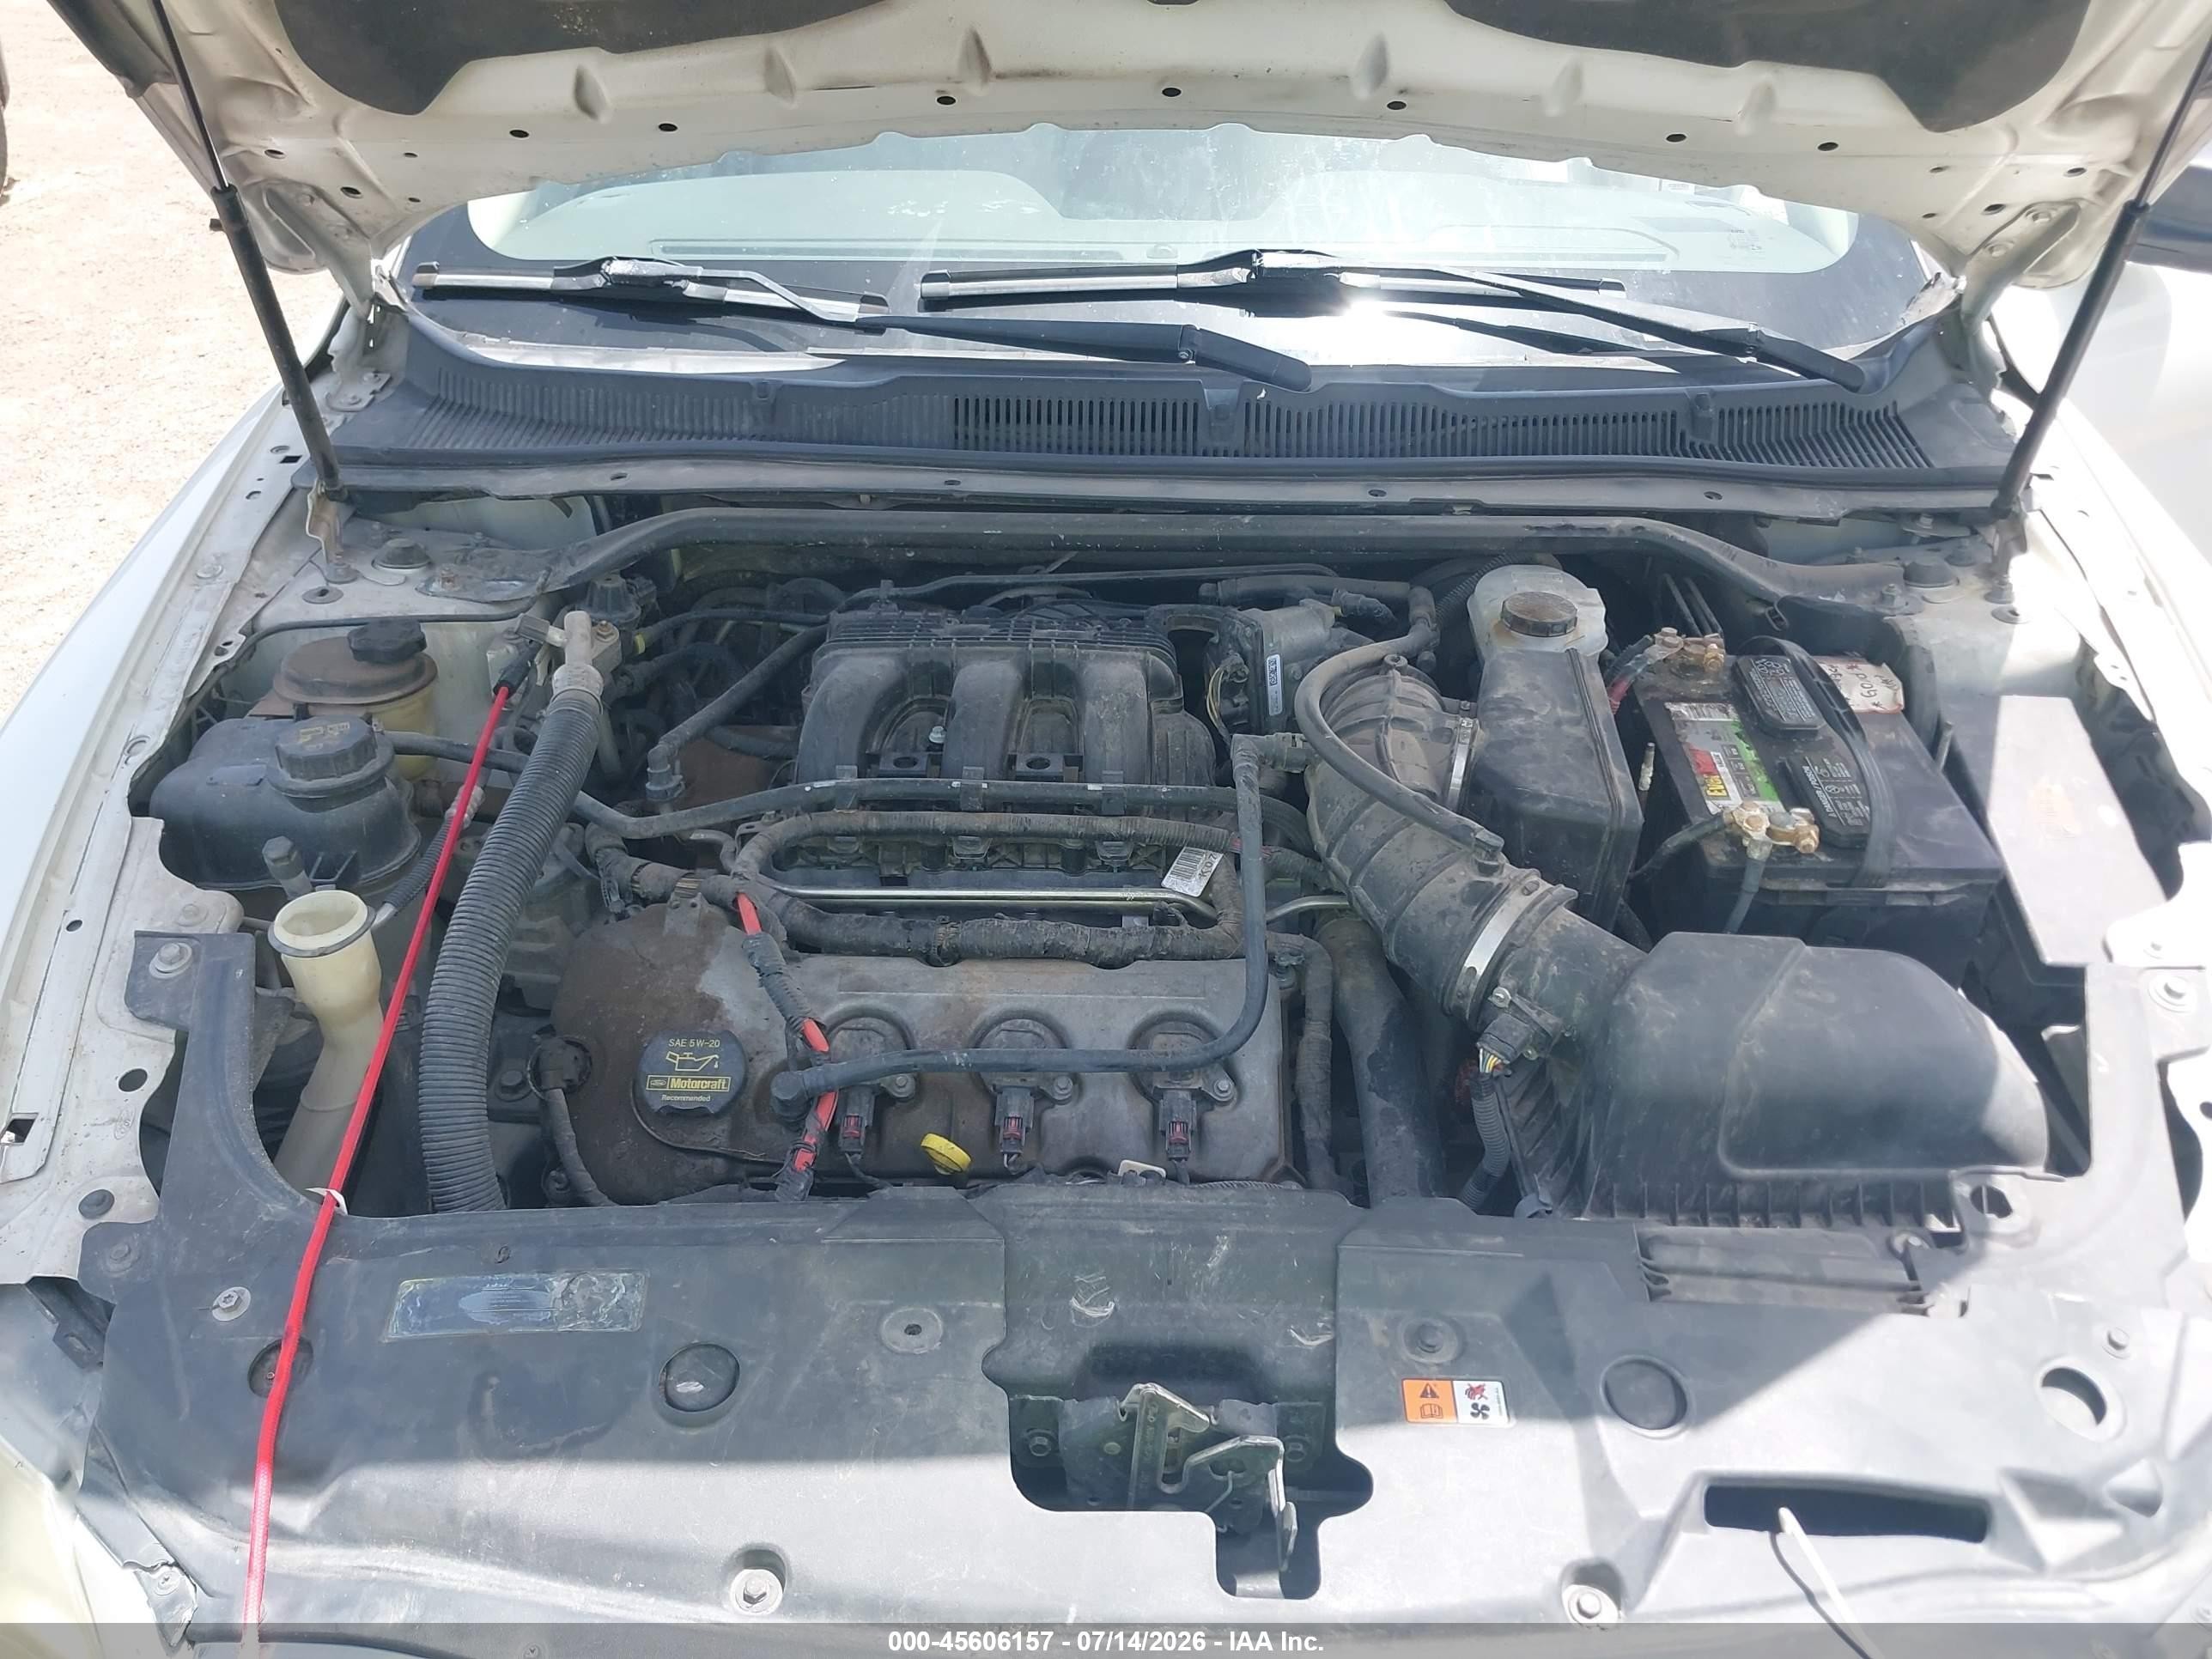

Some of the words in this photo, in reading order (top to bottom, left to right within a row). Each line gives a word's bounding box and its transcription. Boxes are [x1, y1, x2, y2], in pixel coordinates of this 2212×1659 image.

[668, 1038, 687, 1048] SAE
[689, 1038, 720, 1048] 5W-20
[670, 1078, 729, 1091] Motorcraft
